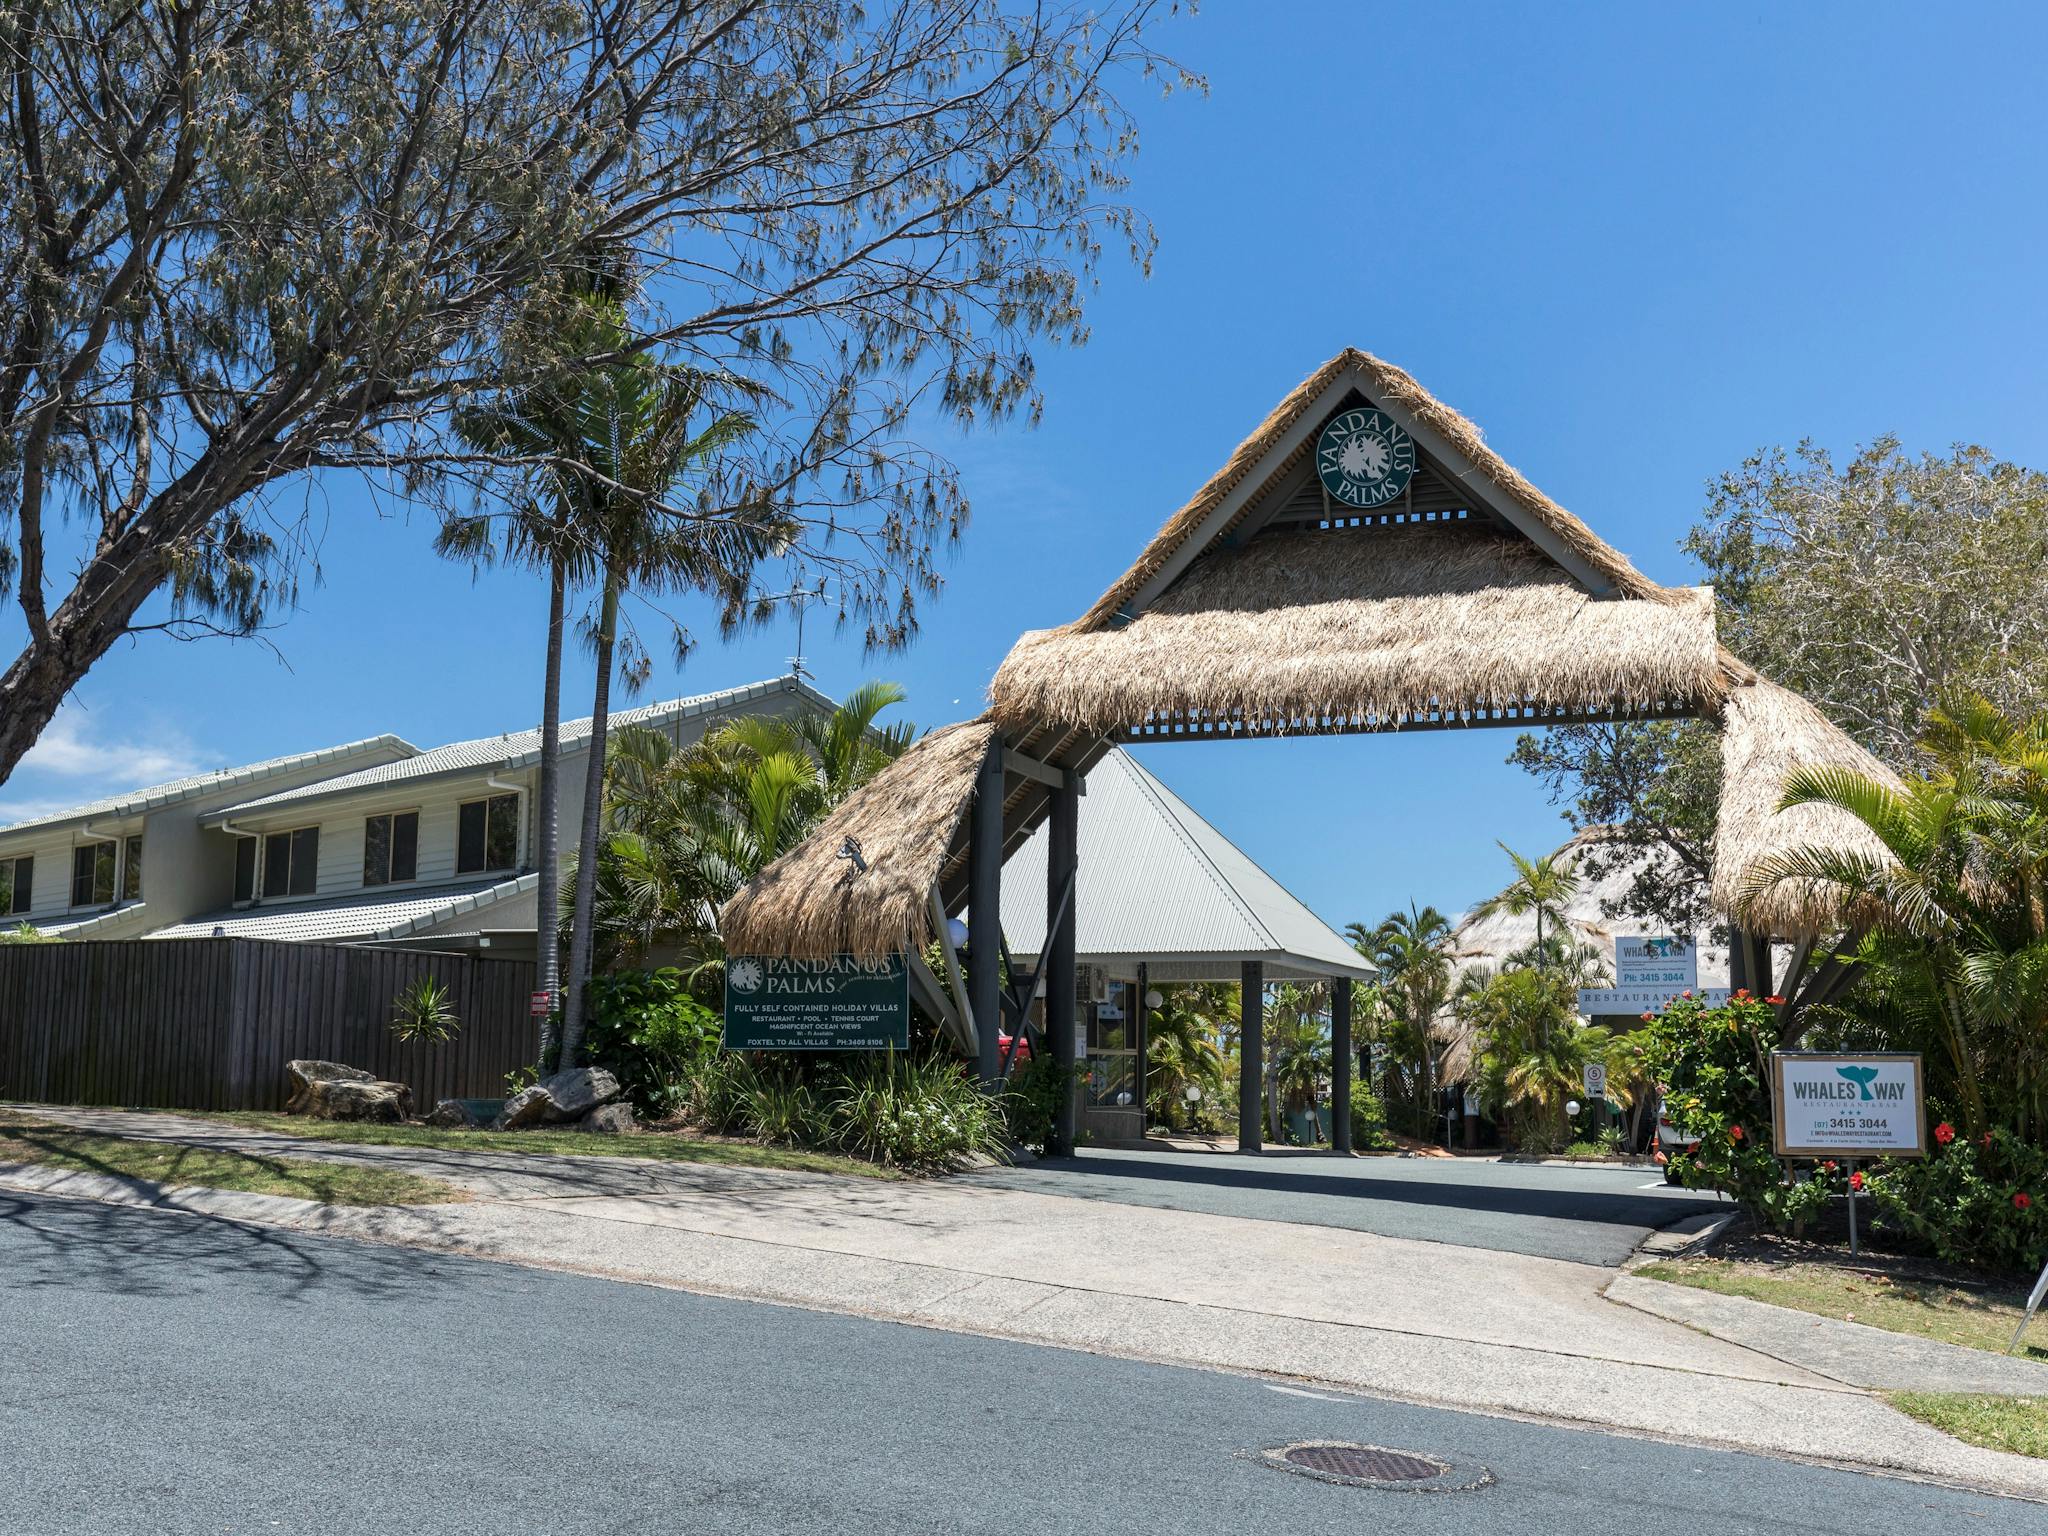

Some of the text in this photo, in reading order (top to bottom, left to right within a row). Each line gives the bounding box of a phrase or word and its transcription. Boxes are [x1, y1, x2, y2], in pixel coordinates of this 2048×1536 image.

[1320, 412, 1412, 475] PANDANUS
[1336, 477, 1399, 505] PALMS
[766, 976, 836, 994] PALMS
[1623, 973, 1685, 983] PH: 3415 3044
[734, 1004, 899, 1012] FULLY SELF CONTAINED HOLIDAY VILLAS
[1793, 1082, 1906, 1100] WHALES WAY
[1830, 1118, 1856, 1129] 3415
[1859, 1118, 1887, 1129] 3044
